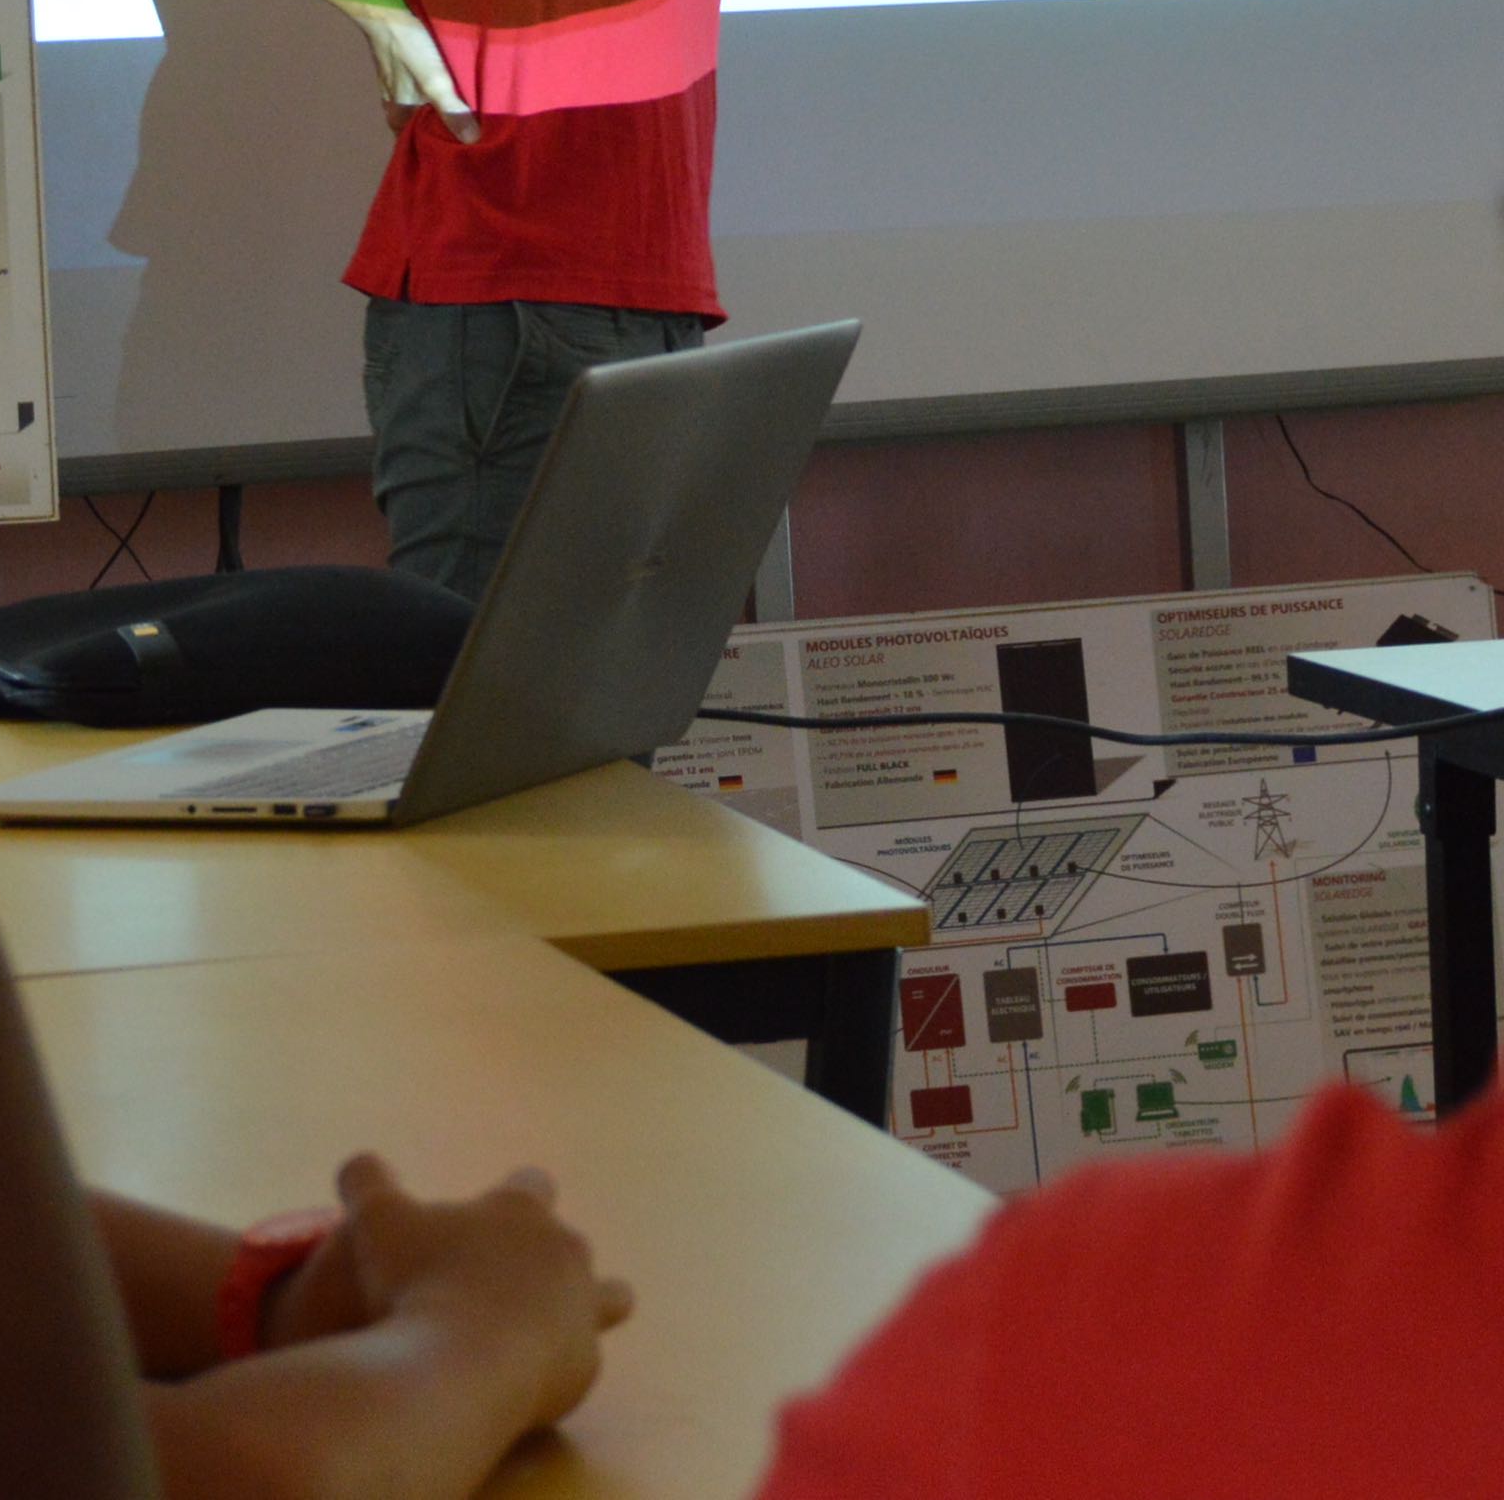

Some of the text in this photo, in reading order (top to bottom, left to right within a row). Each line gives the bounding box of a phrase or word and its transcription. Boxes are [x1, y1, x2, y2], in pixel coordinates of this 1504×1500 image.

[1157, 598, 1344, 624] OPTIMISEURS DE PUISSANCE
[806, 626, 1009, 652] MODULES PHOTOVOLTAÏQUES
[1158, 624, 1233, 641] SOLAREDGE
[807, 653, 886, 670] ALEO SOLAR
[1312, 871, 1386, 888] MONITORING
